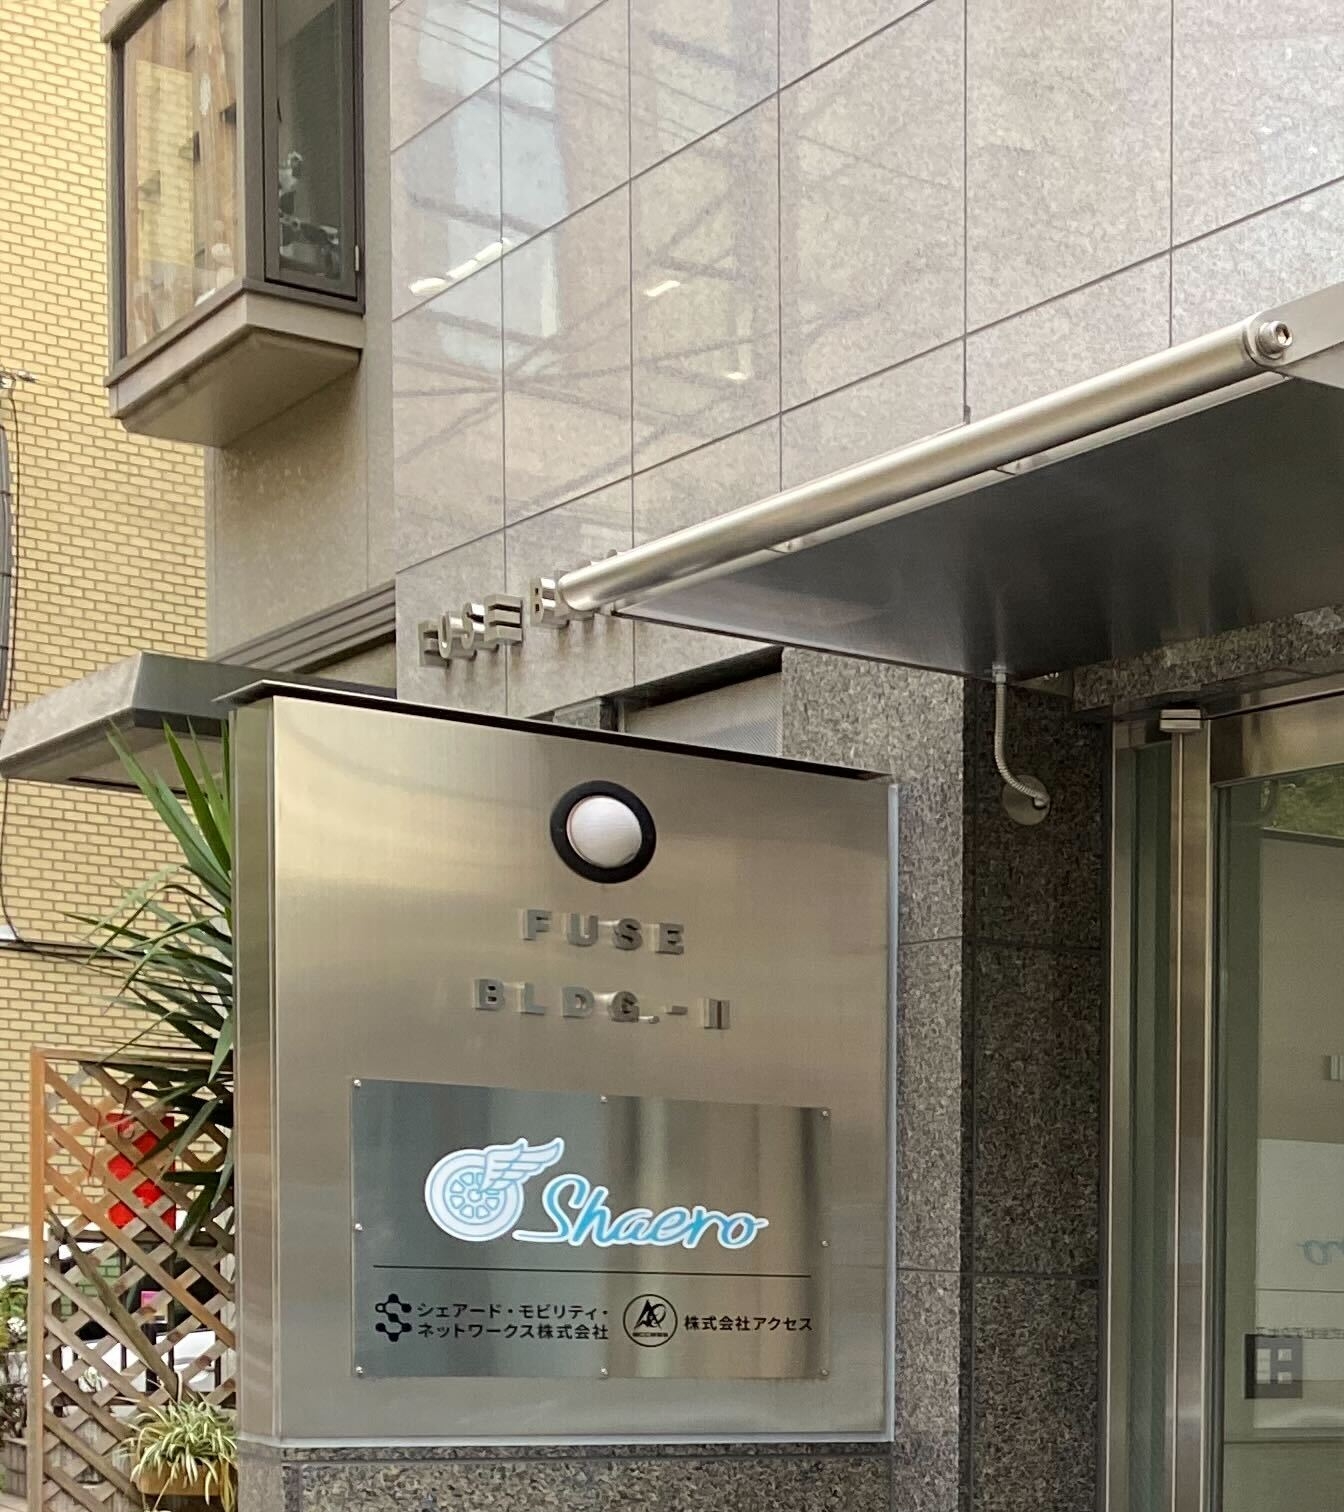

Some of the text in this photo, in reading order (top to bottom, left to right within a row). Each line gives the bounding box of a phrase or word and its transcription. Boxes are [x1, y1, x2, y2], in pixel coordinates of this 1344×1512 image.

[520, 908, 685, 955] FUSE
[512, 1174, 769, 1249] Shaero
[418, 1323, 608, 1340] ネットワークス株式会社
[685, 1315, 813, 1331] 株式会社アクセス
